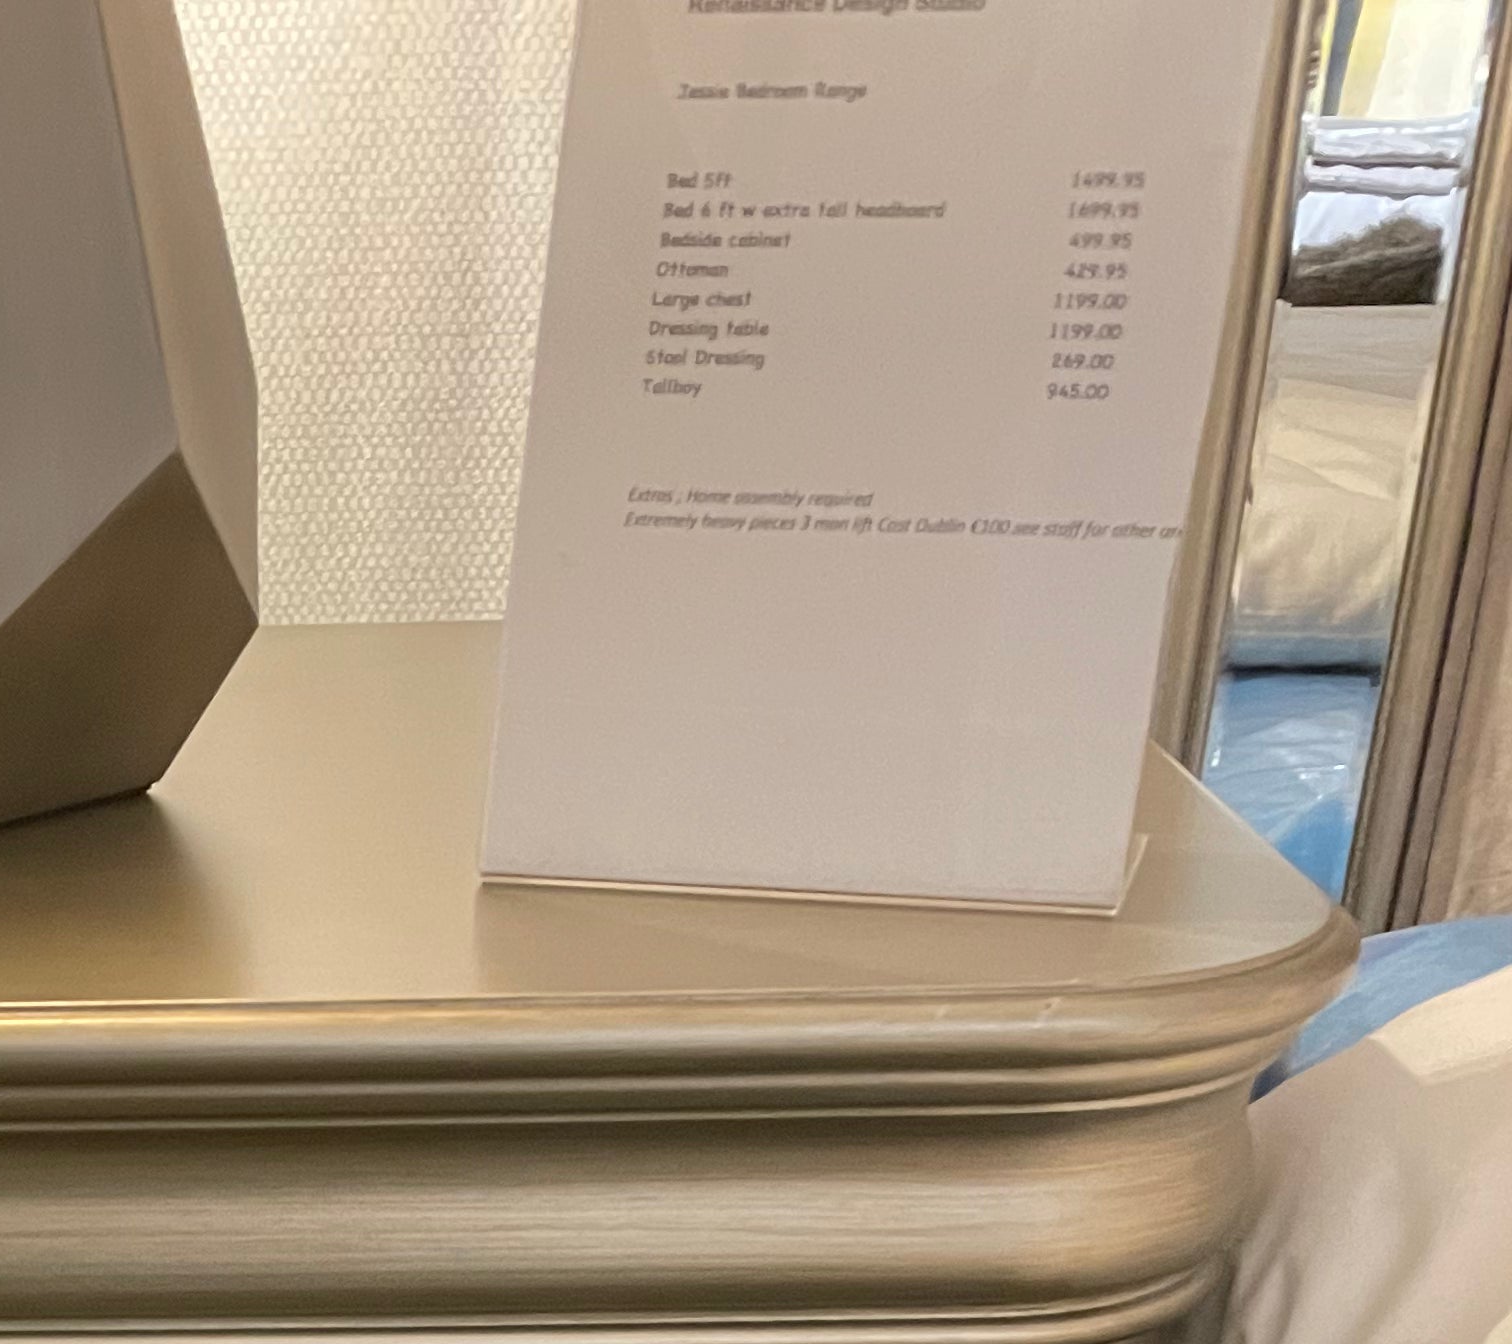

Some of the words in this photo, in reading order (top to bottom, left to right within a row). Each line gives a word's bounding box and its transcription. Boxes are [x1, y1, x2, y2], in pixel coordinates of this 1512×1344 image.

[736, 82, 808, 99] Bedroom
[814, 81, 867, 103] Range
[667, 172, 697, 189] Bed
[703, 172, 732, 189] 5ft
[663, 202, 694, 218] Bed
[718, 202, 734, 218] ft
[763, 203, 810, 218] extra
[855, 201, 947, 219] headboard
[660, 232, 722, 248] Bedside
[728, 232, 791, 248] cabinet
[656, 261, 729, 277] Ottoman
[651, 292, 700, 312] Large
[705, 291, 752, 307] chest
[1054, 293, 1128, 310] 1199.00
[648, 320, 718, 341] Dressing
[727, 321, 769, 337] table
[1050, 322, 1124, 340] 1199.00
[646, 350, 688, 365] Stool
[695, 350, 765, 371] Dressing
[1052, 353, 1115, 370] 269.00
[643, 378, 702, 398] Tallboy
[1047, 383, 1110, 400] 945.00
[688, 491, 731, 503] Home
[807, 491, 874, 507] required
[624, 511, 697, 529] Extremely
